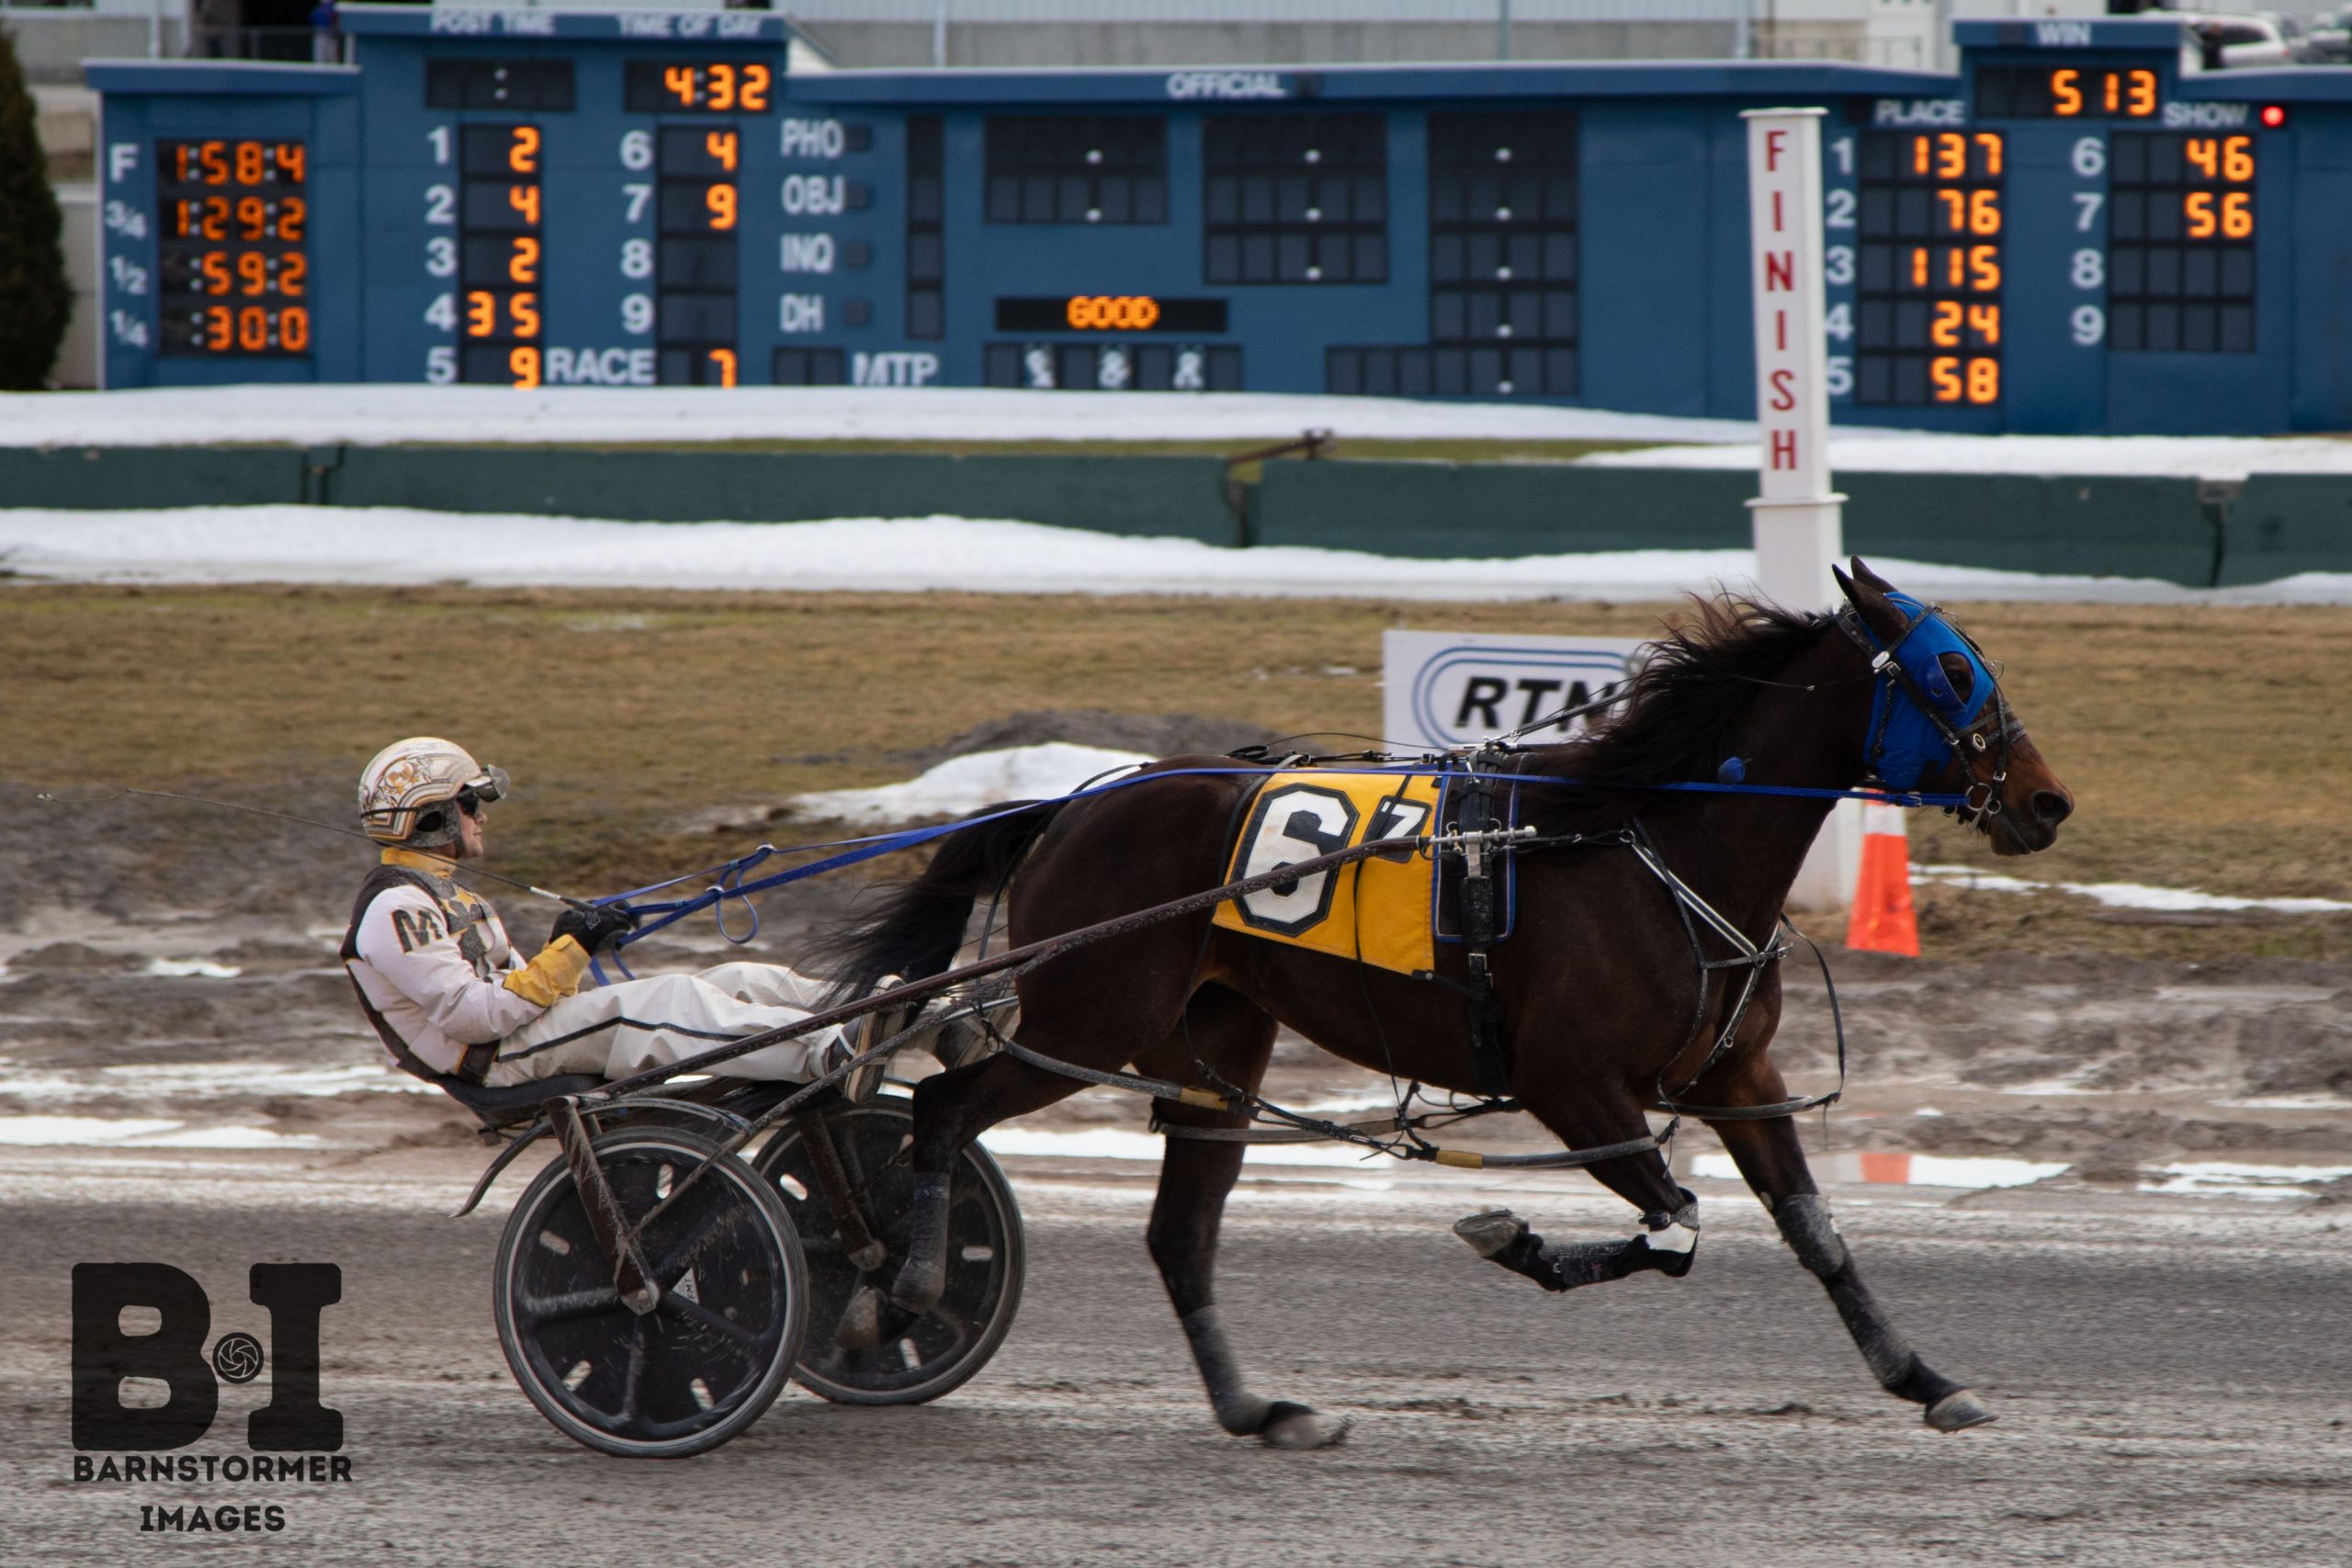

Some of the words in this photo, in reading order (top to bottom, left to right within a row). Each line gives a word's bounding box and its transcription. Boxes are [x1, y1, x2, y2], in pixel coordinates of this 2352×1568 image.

[431, 13, 488, 33] POST
[503, 13, 554, 34] TIME
[620, 14, 673, 35] TIME
[677, 16, 712, 35] OF
[718, 16, 763, 36] DAY
[2036, 22, 2091, 45] WIN
[1166, 72, 1287, 97] OFFICIAL
[1874, 99, 1966, 125] PLACE
[2163, 102, 2248, 127] SHOW
[427, 127, 450, 164] 1
[510, 127, 540, 173] 2
[620, 130, 652, 170] 6
[707, 132, 738, 171] 4
[782, 119, 843, 158] PHO
[1831, 137, 1853, 175] 1
[1914, 133, 2003, 178] 137
[2071, 137, 2105, 176] 6
[111, 143, 140, 182] F
[2186, 136, 2254, 181] 46
[425, 185, 455, 224] 2
[510, 186, 540, 224] 4
[623, 185, 651, 222] 7
[707, 184, 737, 230] 9
[782, 175, 845, 214] OBJ
[1826, 189, 1856, 228] 2
[1938, 189, 2001, 235] 76
[2073, 192, 2104, 231] 7
[2185, 192, 2254, 238] 56
[426, 238, 457, 276] 3
[510, 238, 540, 283] 2
[621, 239, 653, 278] 8
[1825, 245, 1855, 285] 3
[1912, 245, 2000, 290] 115
[2071, 249, 2105, 289] 8
[424, 294, 457, 331] 4
[621, 294, 654, 333] 9
[781, 294, 824, 332] DH
[1067, 295, 1160, 329] GOOD
[1765, 130, 1797, 470] FINISH
[1826, 303, 1853, 341] 4
[1931, 301, 2000, 346] 24
[2071, 305, 2105, 345] 9
[426, 347, 458, 383] 5
[510, 347, 540, 389] 9
[547, 348, 656, 384] RACE
[854, 354, 938, 386] MTP
[1826, 358, 1854, 397] 5
[1931, 357, 1999, 403] 58
[1240, 788, 1351, 926] 6
[390, 908, 444, 955] M
